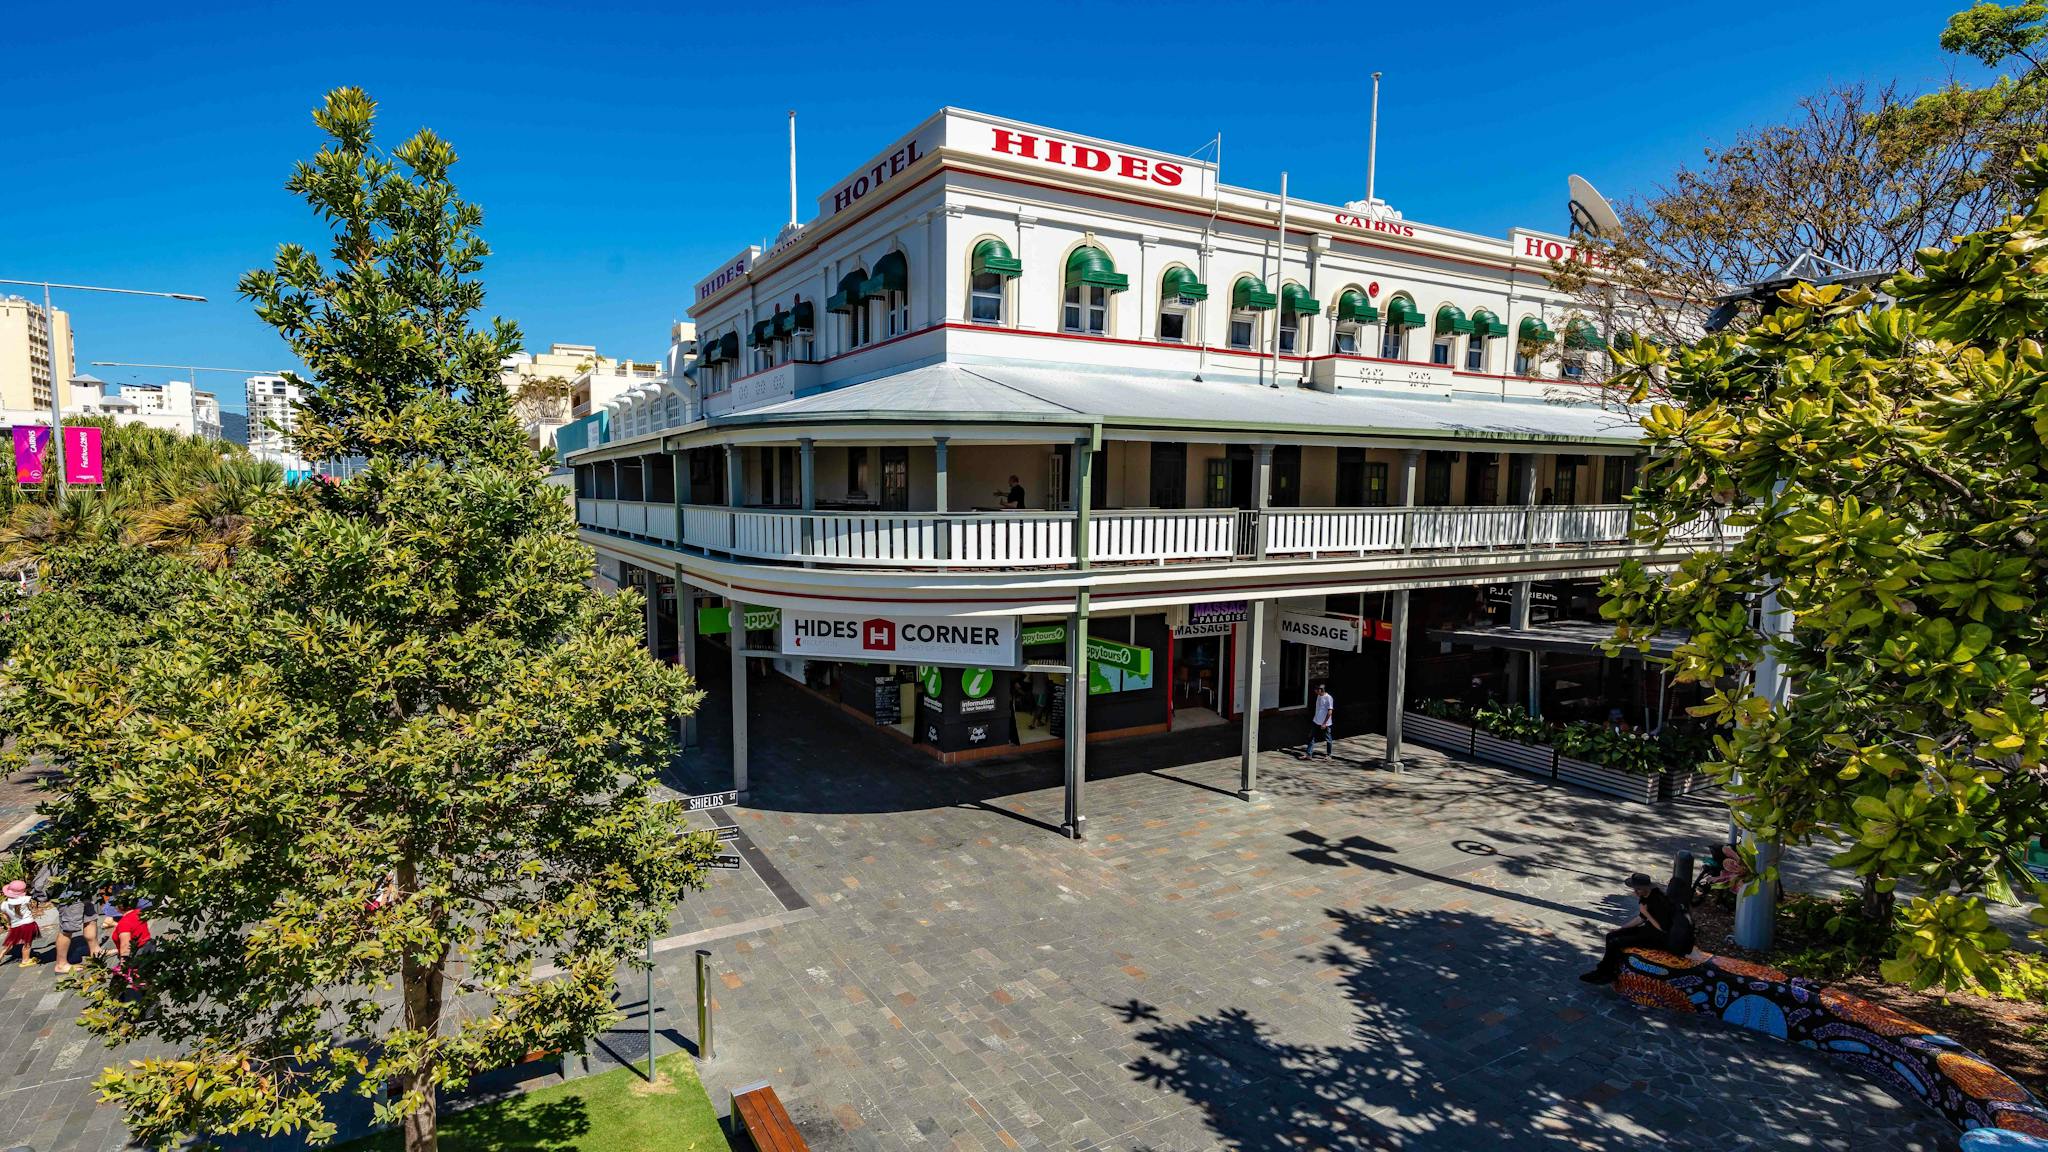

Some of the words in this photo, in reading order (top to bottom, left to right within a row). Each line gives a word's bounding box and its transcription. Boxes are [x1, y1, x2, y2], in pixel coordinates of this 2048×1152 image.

[991, 128, 1184, 187] HIDES
[834, 140, 923, 215] HOTEL
[1335, 213, 1414, 238] CAIRNS
[701, 260, 745, 299] HIDES
[28, 430, 37, 453] CAIRNS
[1194, 602, 1248, 617] MASSAG
[1199, 613, 1247, 624] PARADISE
[794, 619, 858, 639] HIDES
[901, 624, 1000, 646] CORNER
[1036, 631, 1056, 640] tours
[1175, 623, 1230, 636] MASSAGE
[1282, 619, 1349, 641] MASSAGE
[1100, 646, 1122, 661] tours
[961, 698, 995, 708] information
[690, 795, 723, 810] SHIELDS
